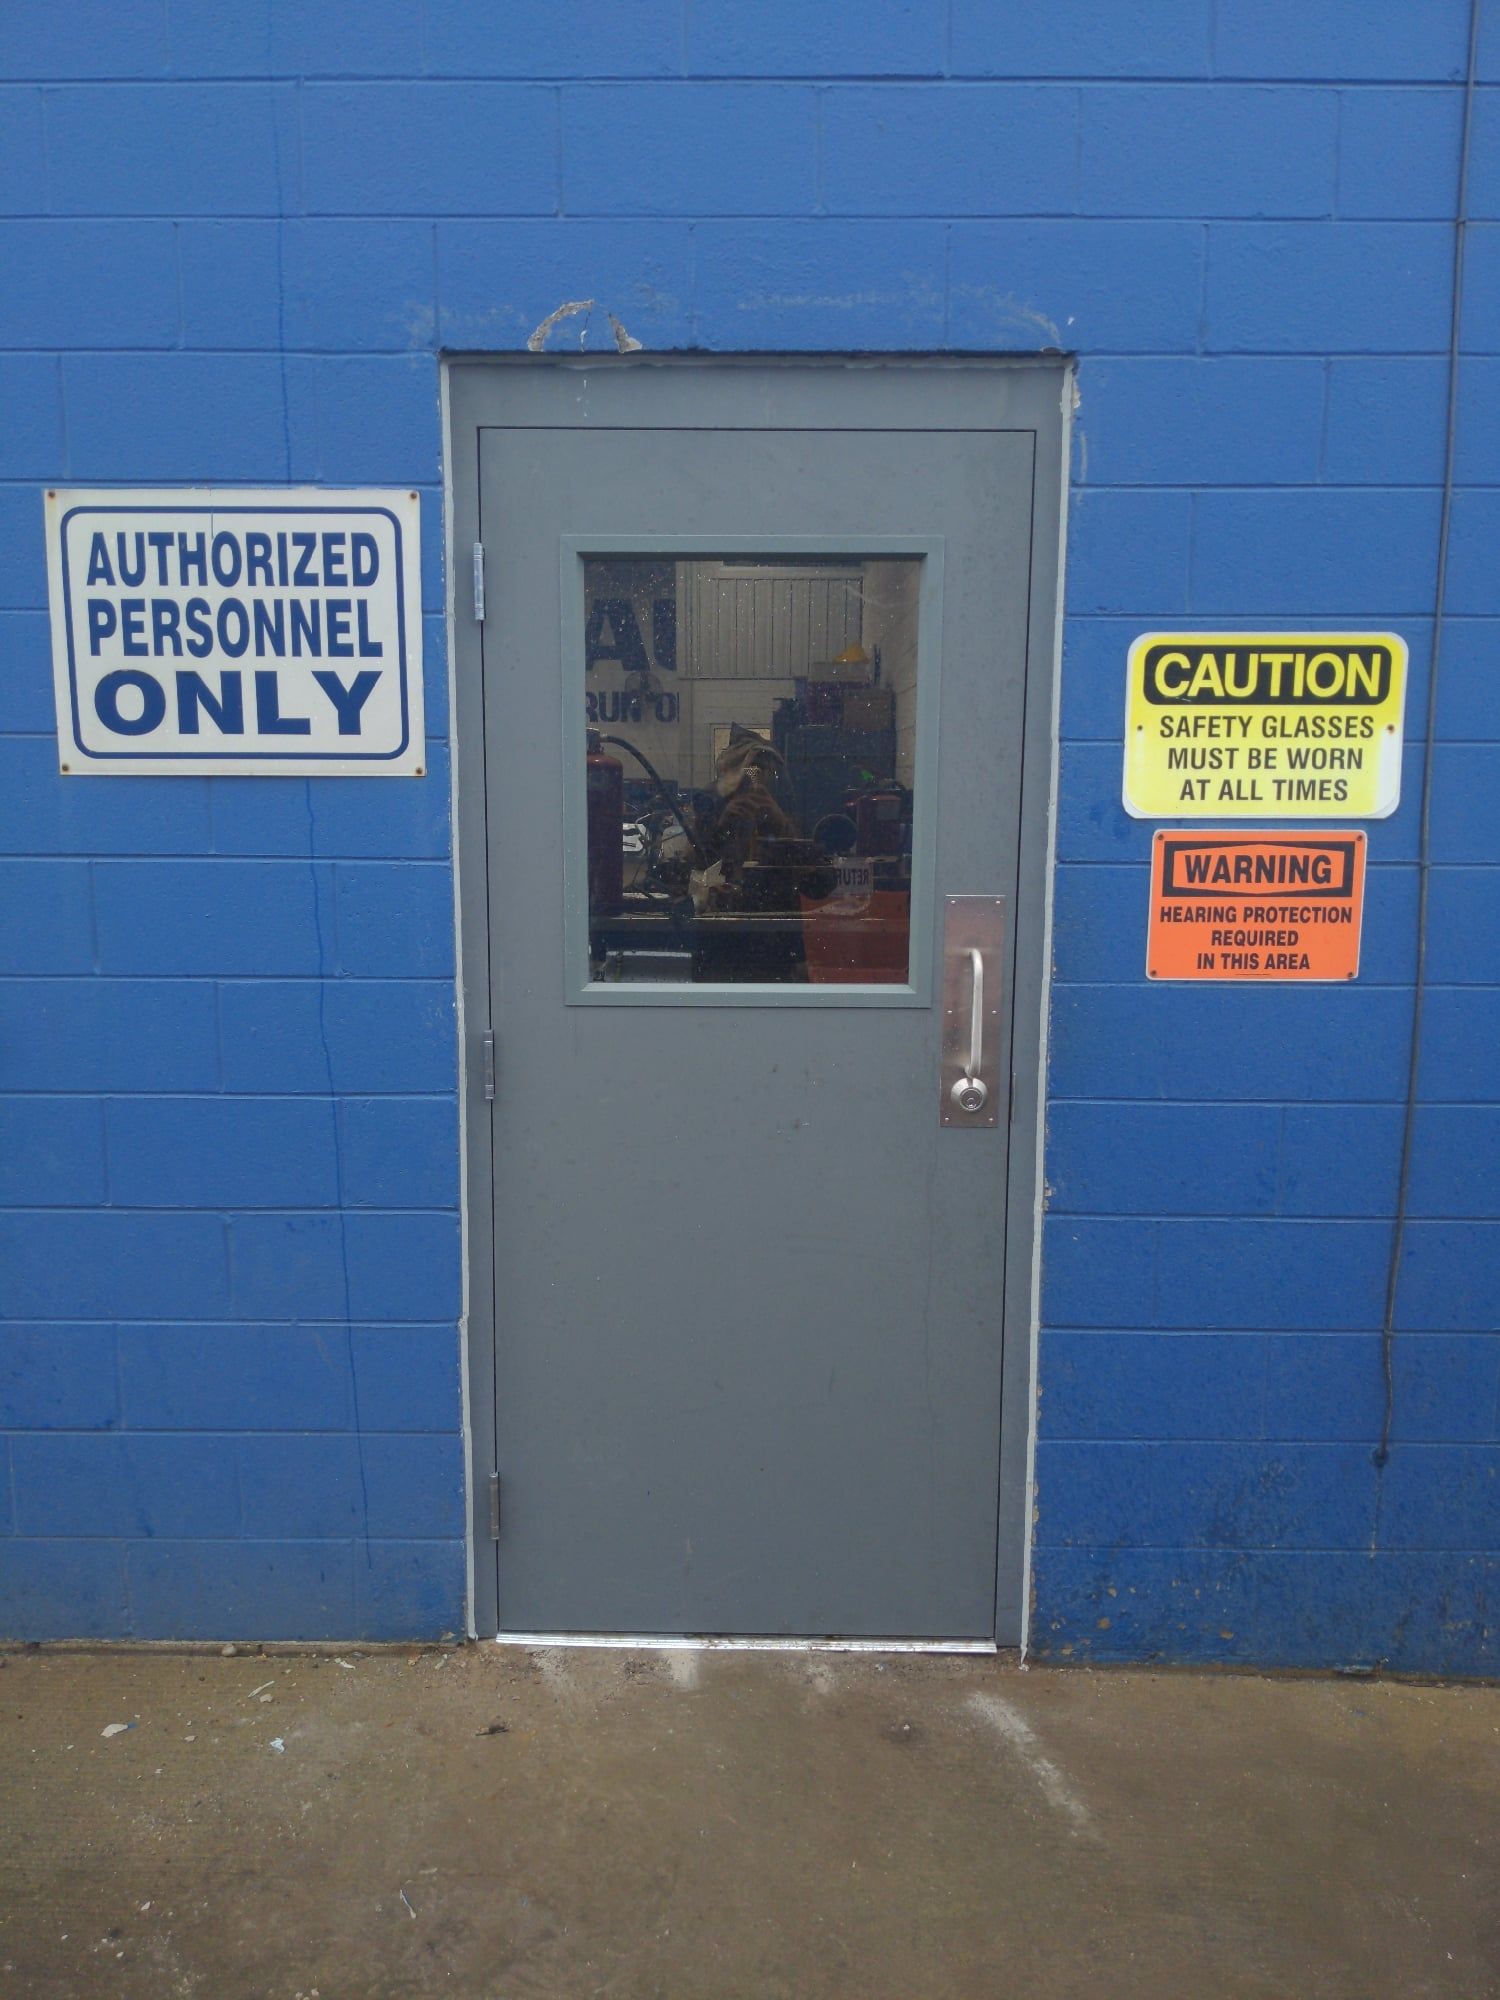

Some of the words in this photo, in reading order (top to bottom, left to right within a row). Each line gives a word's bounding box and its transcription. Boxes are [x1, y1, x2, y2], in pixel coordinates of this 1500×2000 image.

[87, 530, 380, 587] AUTHORIZED
[87, 597, 383, 658] PERSONNEL
[1155, 652, 1381, 697] CAUTION
[94, 669, 383, 735] ONLY
[1160, 715, 1253, 738] SAFETY
[1261, 715, 1374, 738] GLASSES
[1168, 748, 1239, 770] MUST
[1248, 748, 1277, 769] BE
[1287, 748, 1363, 770] WORN
[1180, 779, 1210, 801] AT
[1218, 779, 1263, 801] ALL
[1272, 779, 1348, 801] TIMES
[1185, 855, 1332, 884] WARNING
[1160, 906, 1236, 923] HEARING
[1243, 906, 1352, 924] PROTECTION
[1211, 930, 1299, 947] REQUIRED
[1197, 953, 1215, 970] IN
[1221, 953, 1260, 970] THIS
[1265, 953, 1310, 970] AREA
